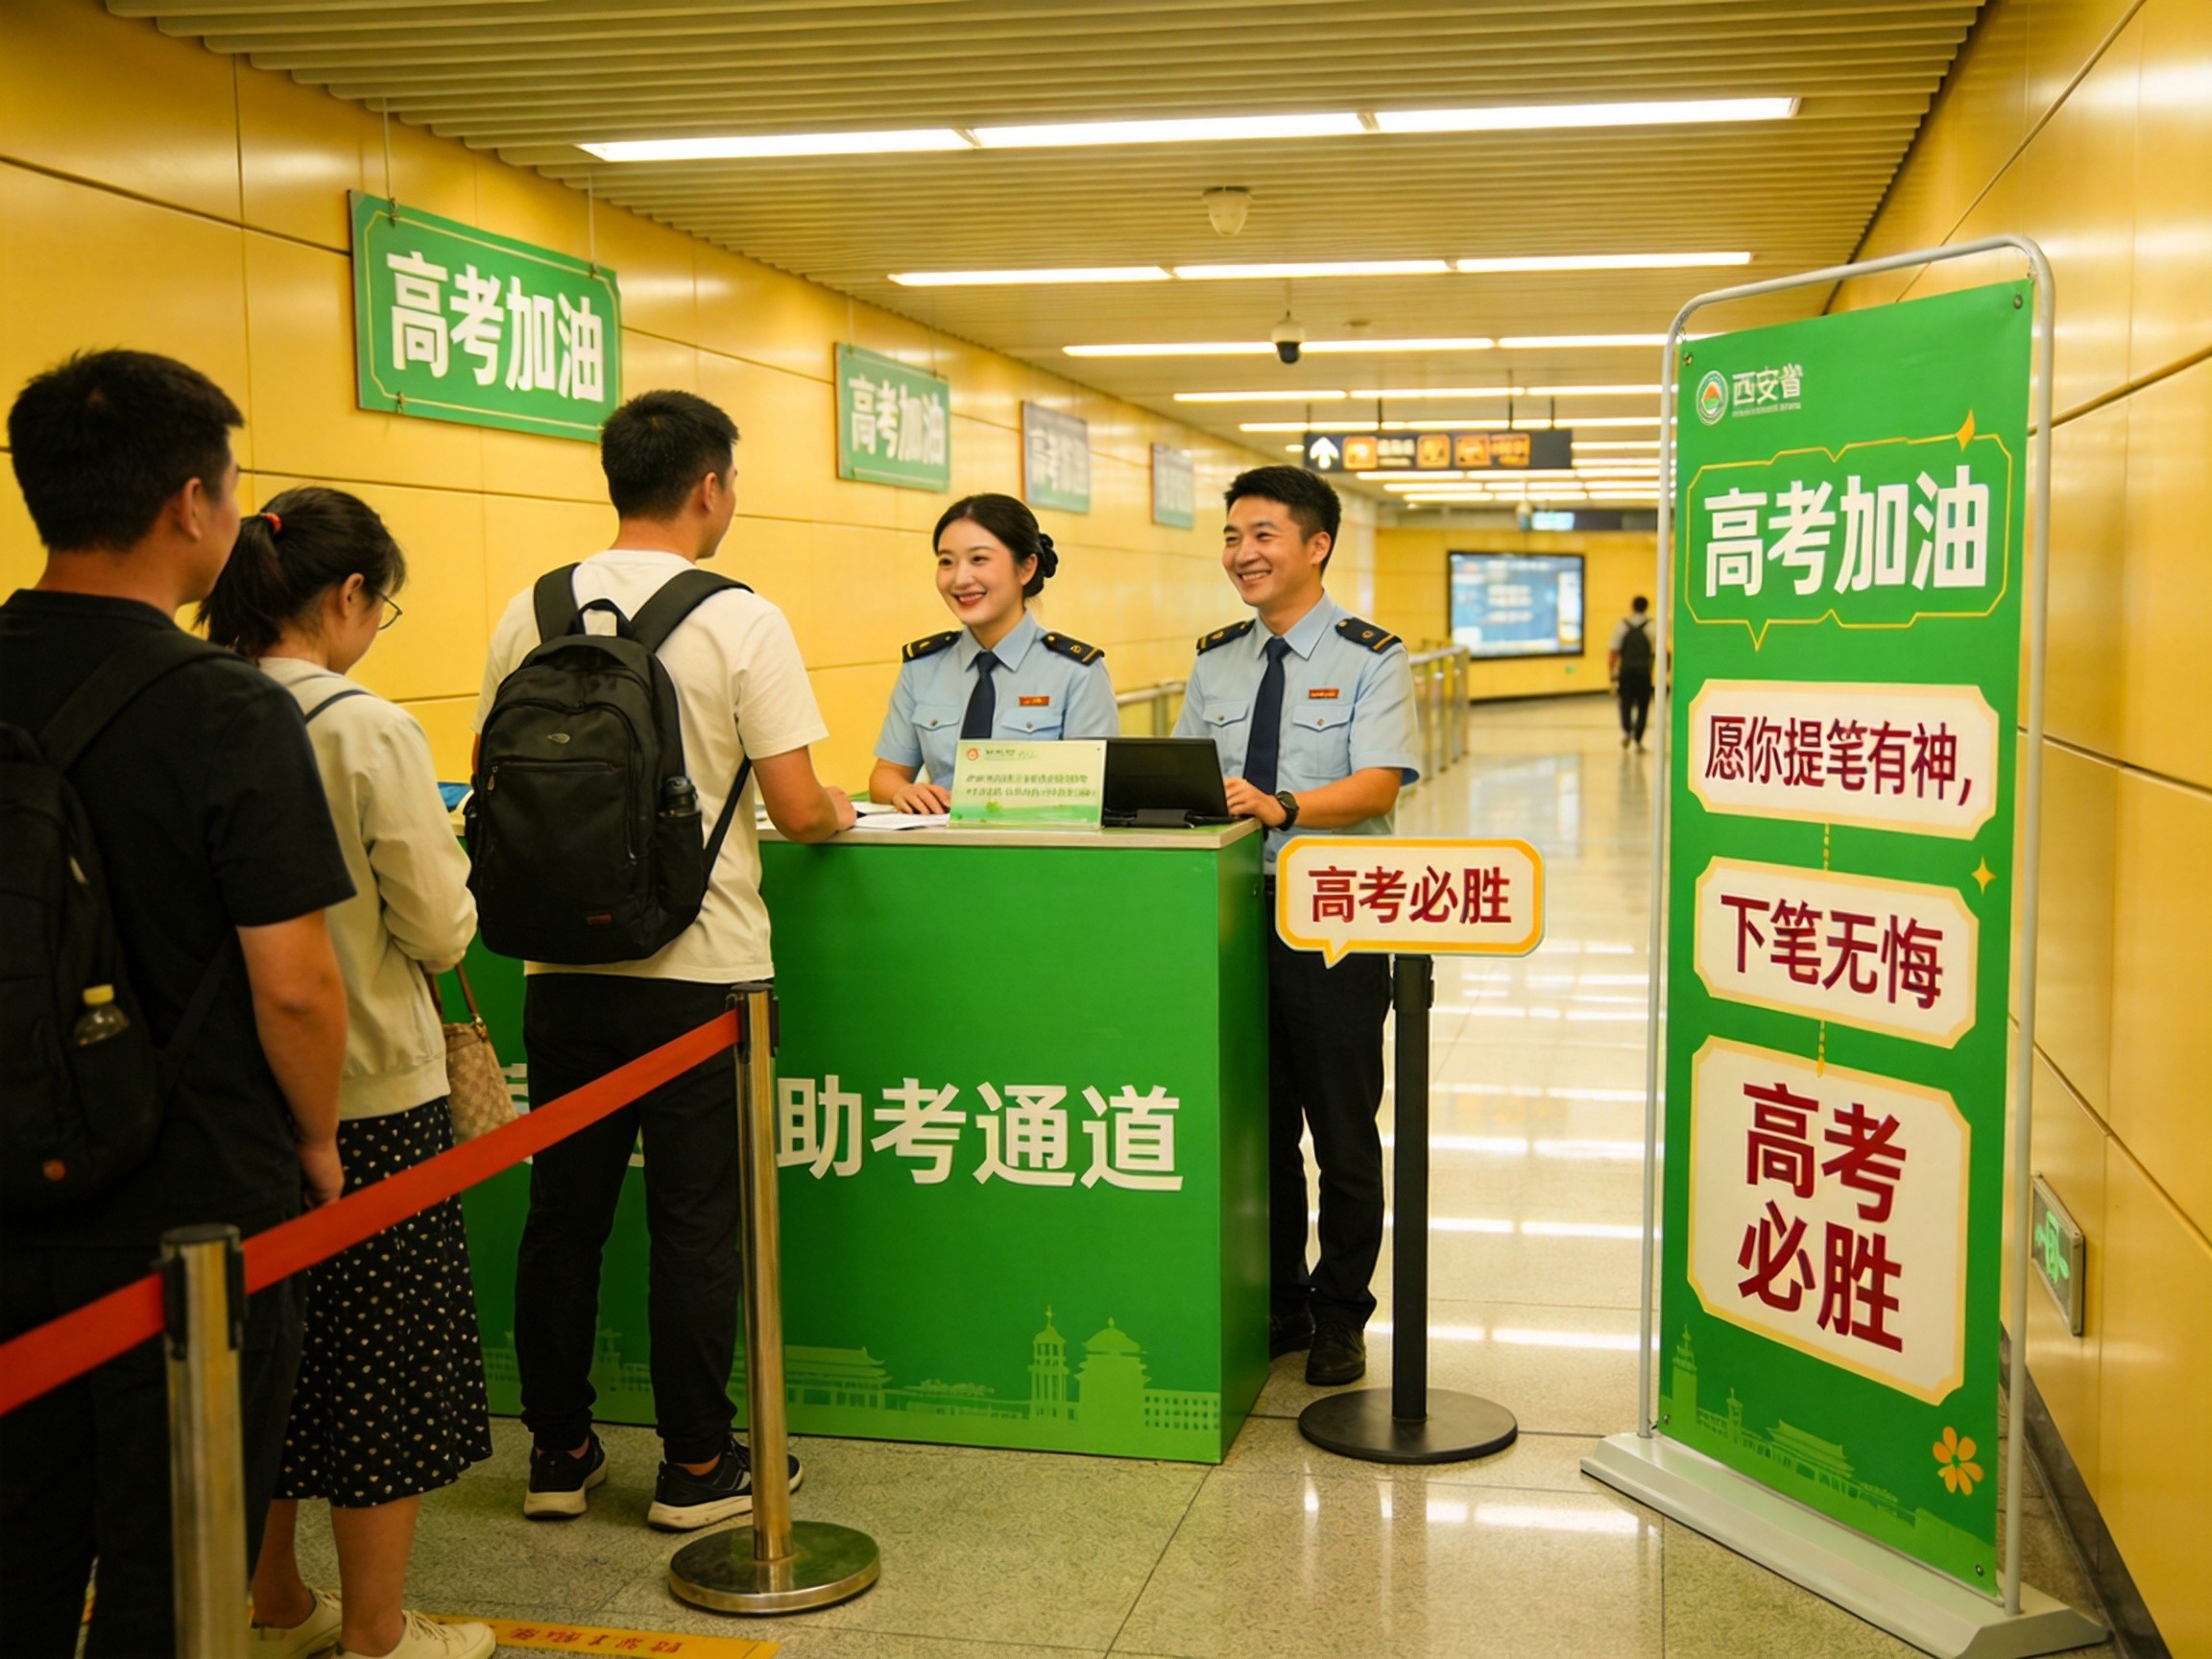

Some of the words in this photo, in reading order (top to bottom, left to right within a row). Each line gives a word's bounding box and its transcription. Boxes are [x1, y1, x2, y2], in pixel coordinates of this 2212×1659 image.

[386, 251, 604, 403] 高考加油
[848, 373, 945, 467] 高考加油
[1704, 465, 1989, 597] 高考加油
[1705, 715, 1972, 805] 愿你提笔有神,
[1308, 865, 1512, 925] 高考必胜
[1720, 894, 1943, 1009] 下笔无悔
[1743, 1082, 1907, 1223] 高考
[1737, 1199, 1903, 1354] 必胜
